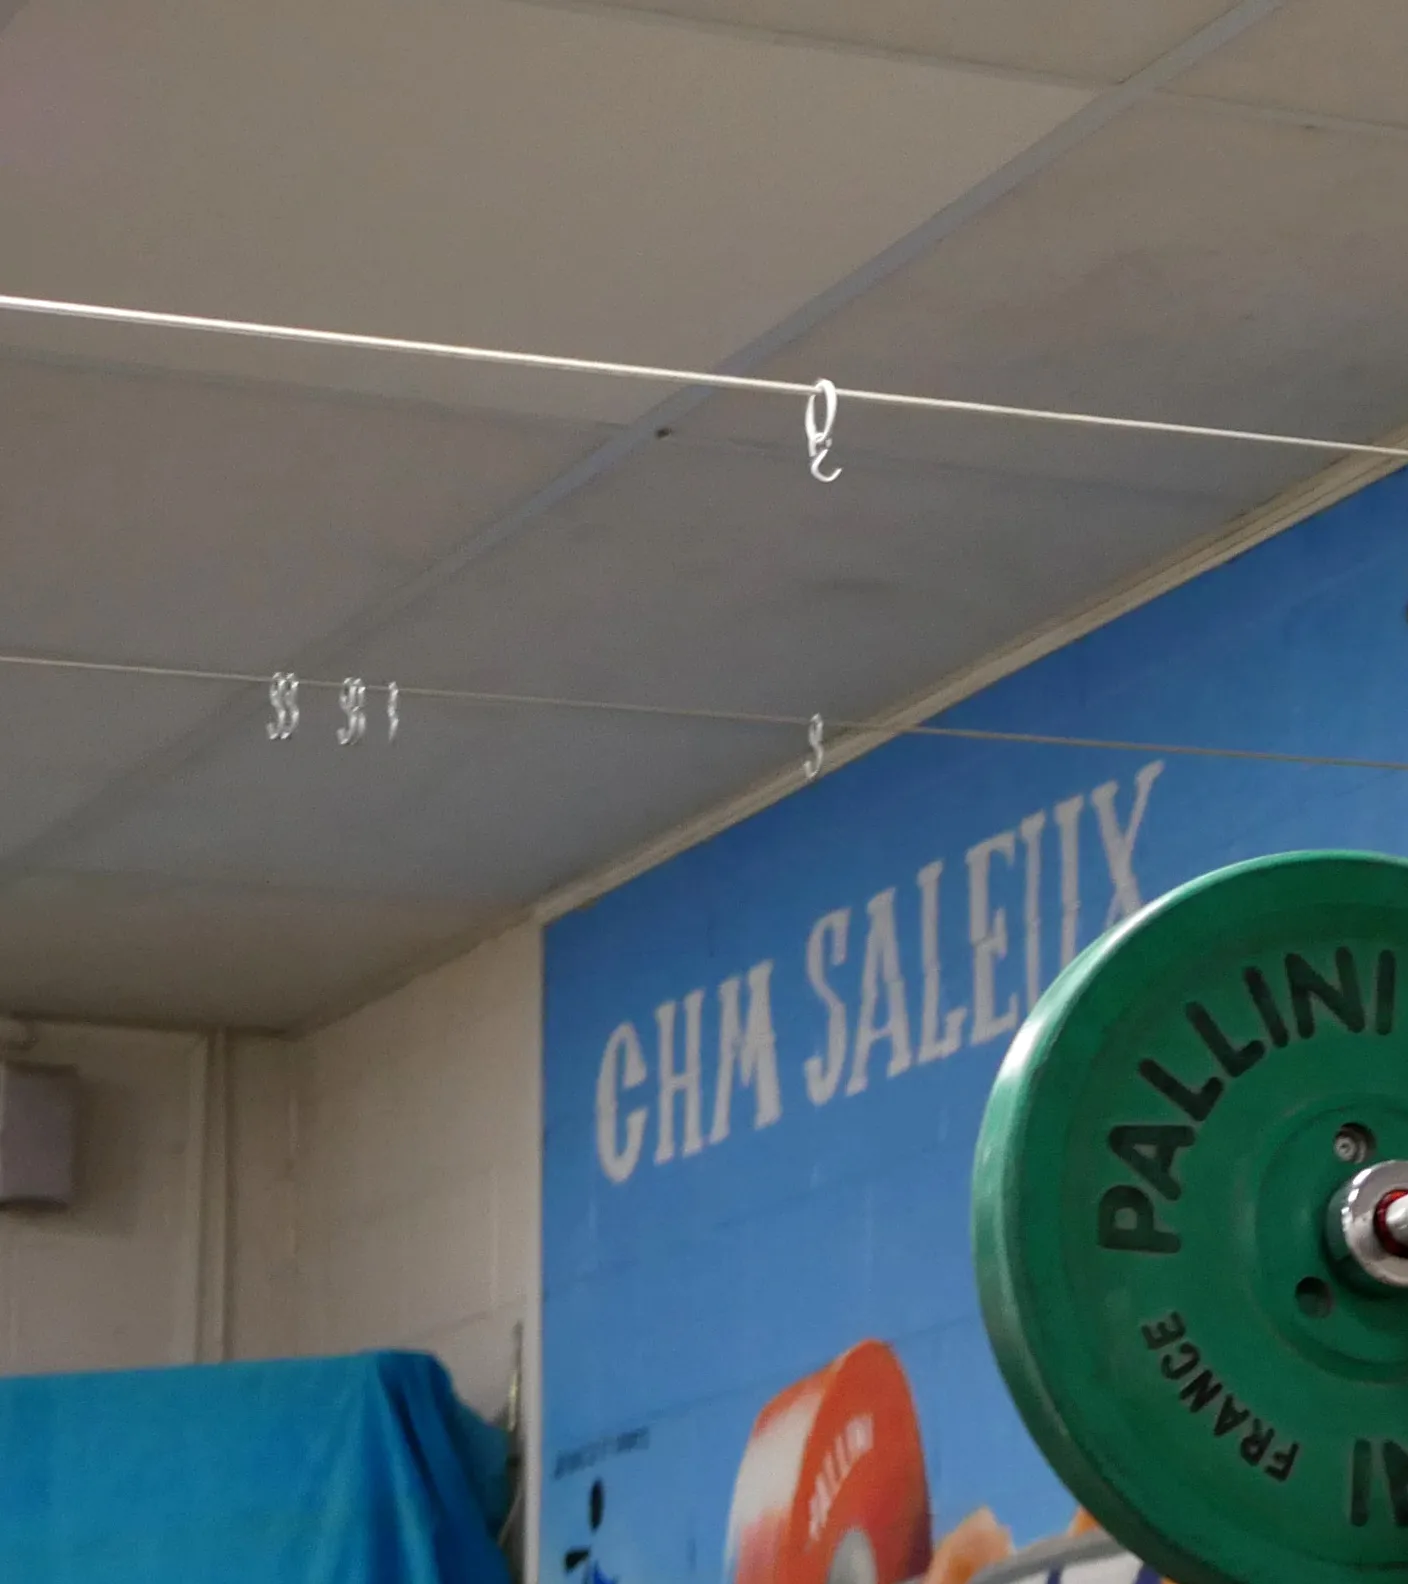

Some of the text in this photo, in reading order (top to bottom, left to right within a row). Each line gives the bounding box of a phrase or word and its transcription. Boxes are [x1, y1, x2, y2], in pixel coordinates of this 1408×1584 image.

[595, 760, 1165, 1184] CHM SALEUX
[1095, 946, 1397, 1256] PALLINI
[1140, 1310, 1301, 1484] FRANCE
